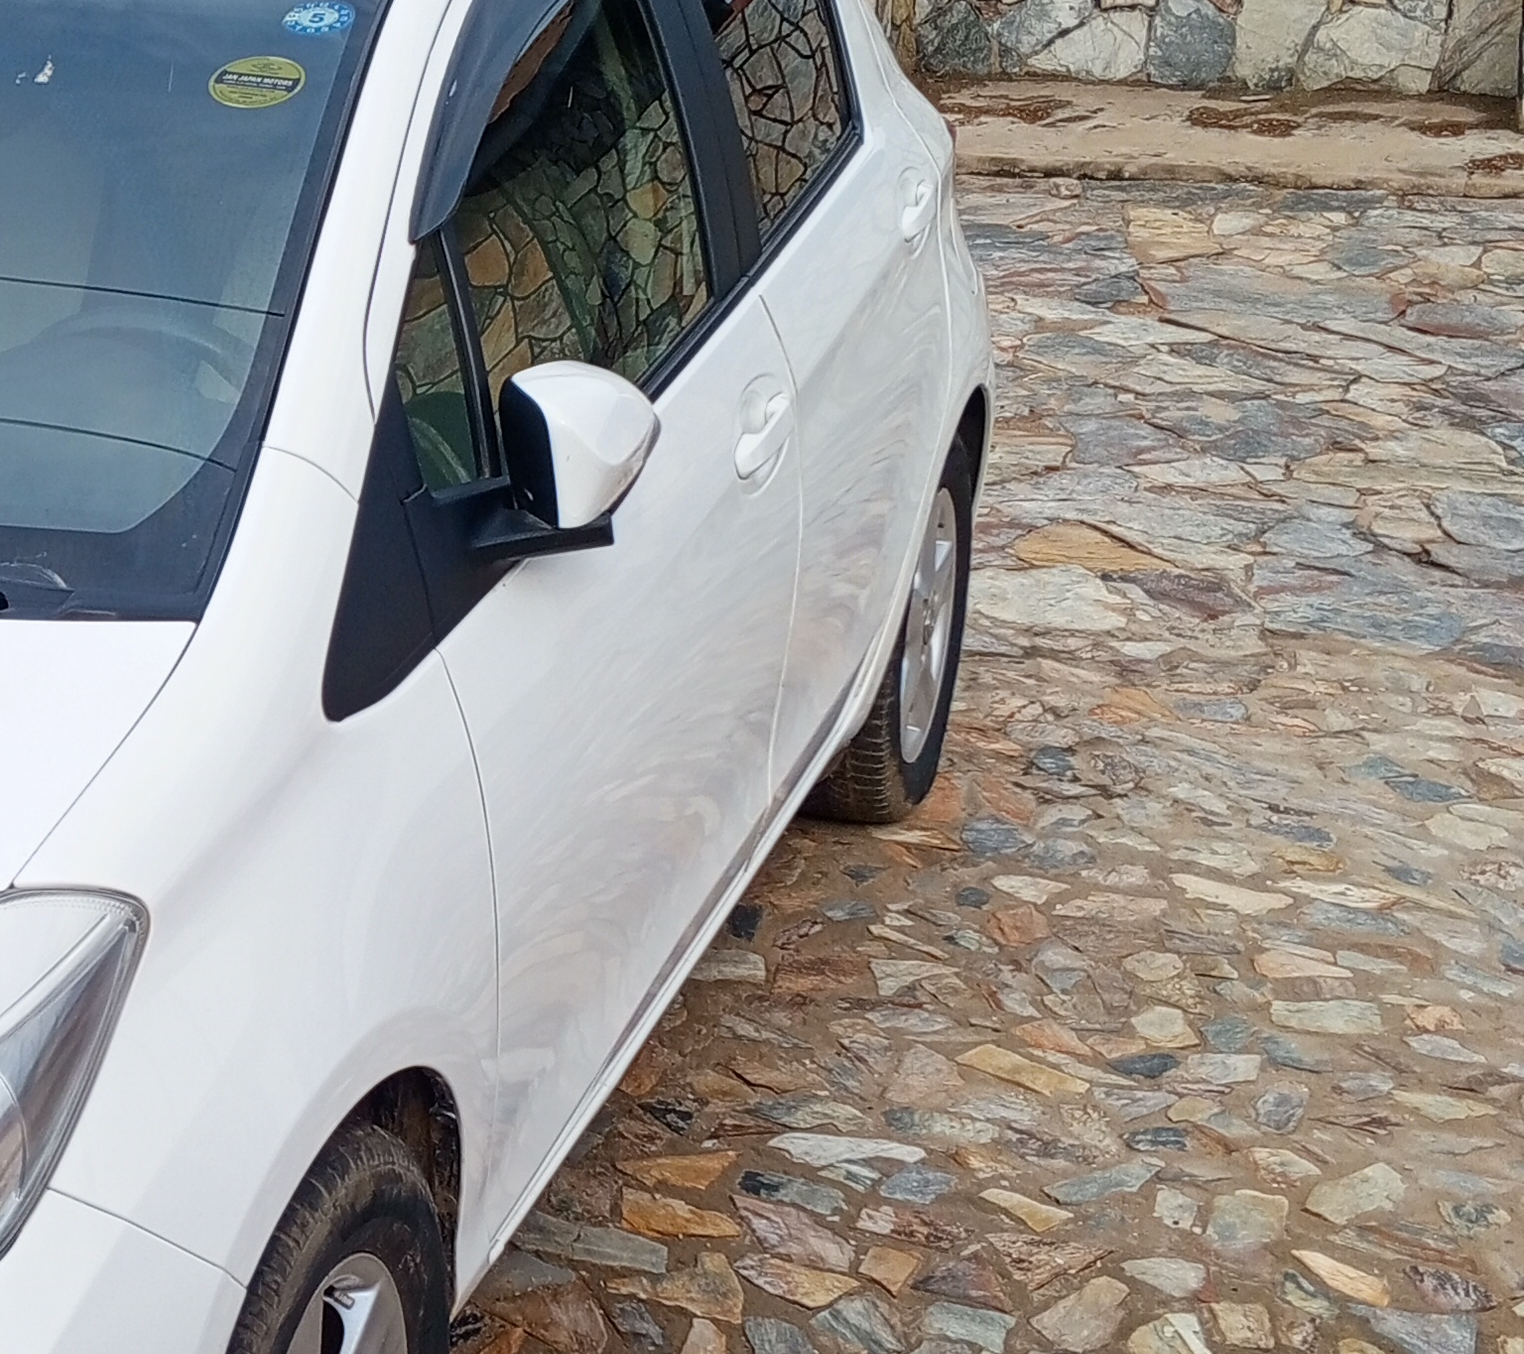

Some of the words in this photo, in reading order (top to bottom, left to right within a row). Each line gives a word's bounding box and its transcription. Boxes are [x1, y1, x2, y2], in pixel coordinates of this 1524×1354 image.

[308, 12, 326, 24] 5
[238, 75, 262, 83] JAPAN
[263, 77, 293, 86] MOTORS
